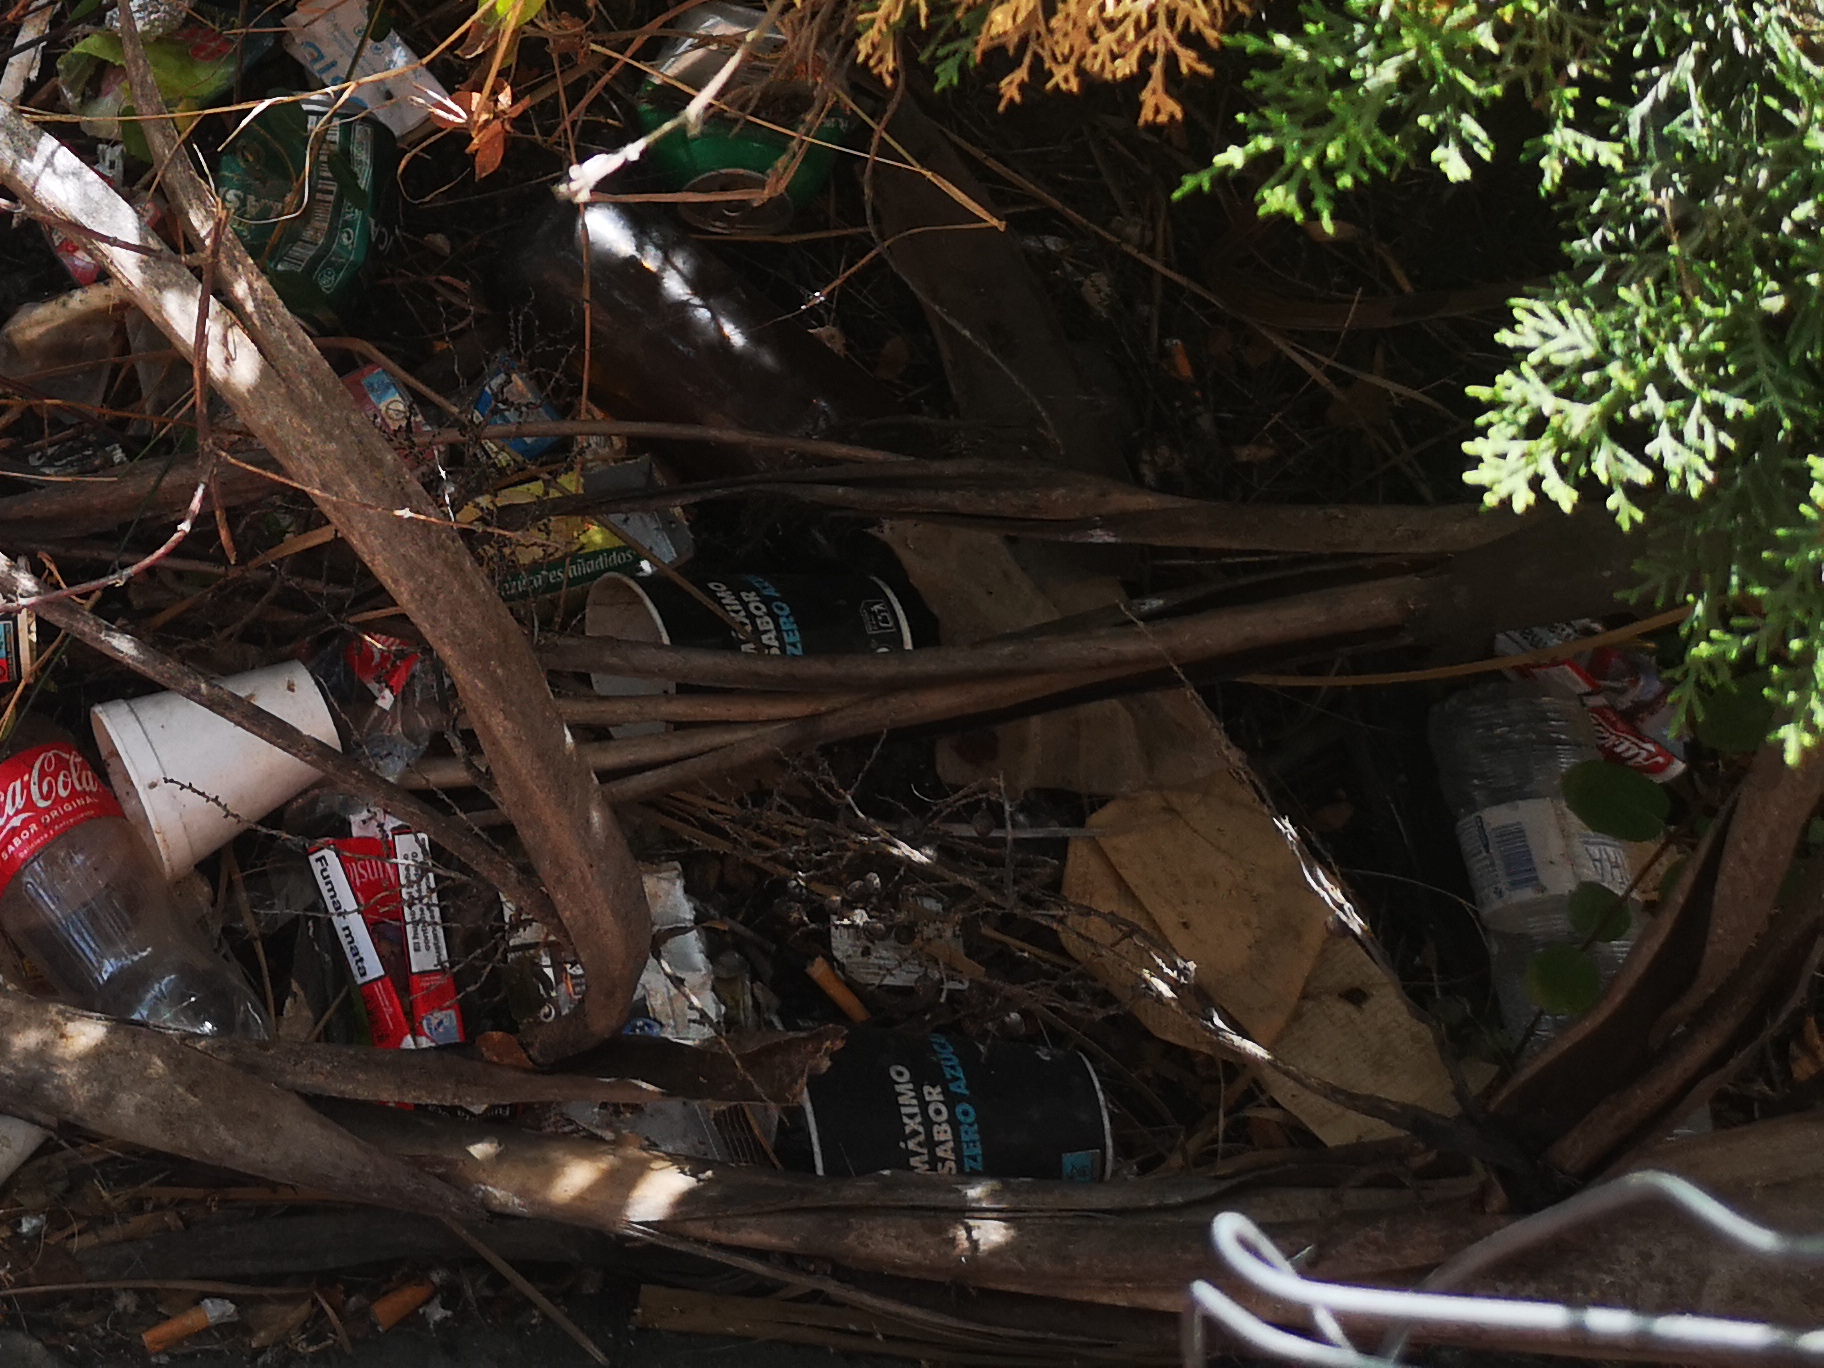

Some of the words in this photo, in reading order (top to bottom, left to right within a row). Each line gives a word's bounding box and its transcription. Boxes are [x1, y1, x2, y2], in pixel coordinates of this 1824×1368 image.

[568, 549, 634, 579] añadidos
[773, 602, 805, 658] ZERO
[1, 823, 39, 861] SABOR
[40, 795, 99, 825] ORIGINAL
[315, 853, 347, 920] Fumar
[341, 924, 367, 978] mata
[888, 1063, 939, 1175] MÁXIMO
[922, 1082, 958, 1176] SABOR
[954, 1102, 984, 1173] ZERO
